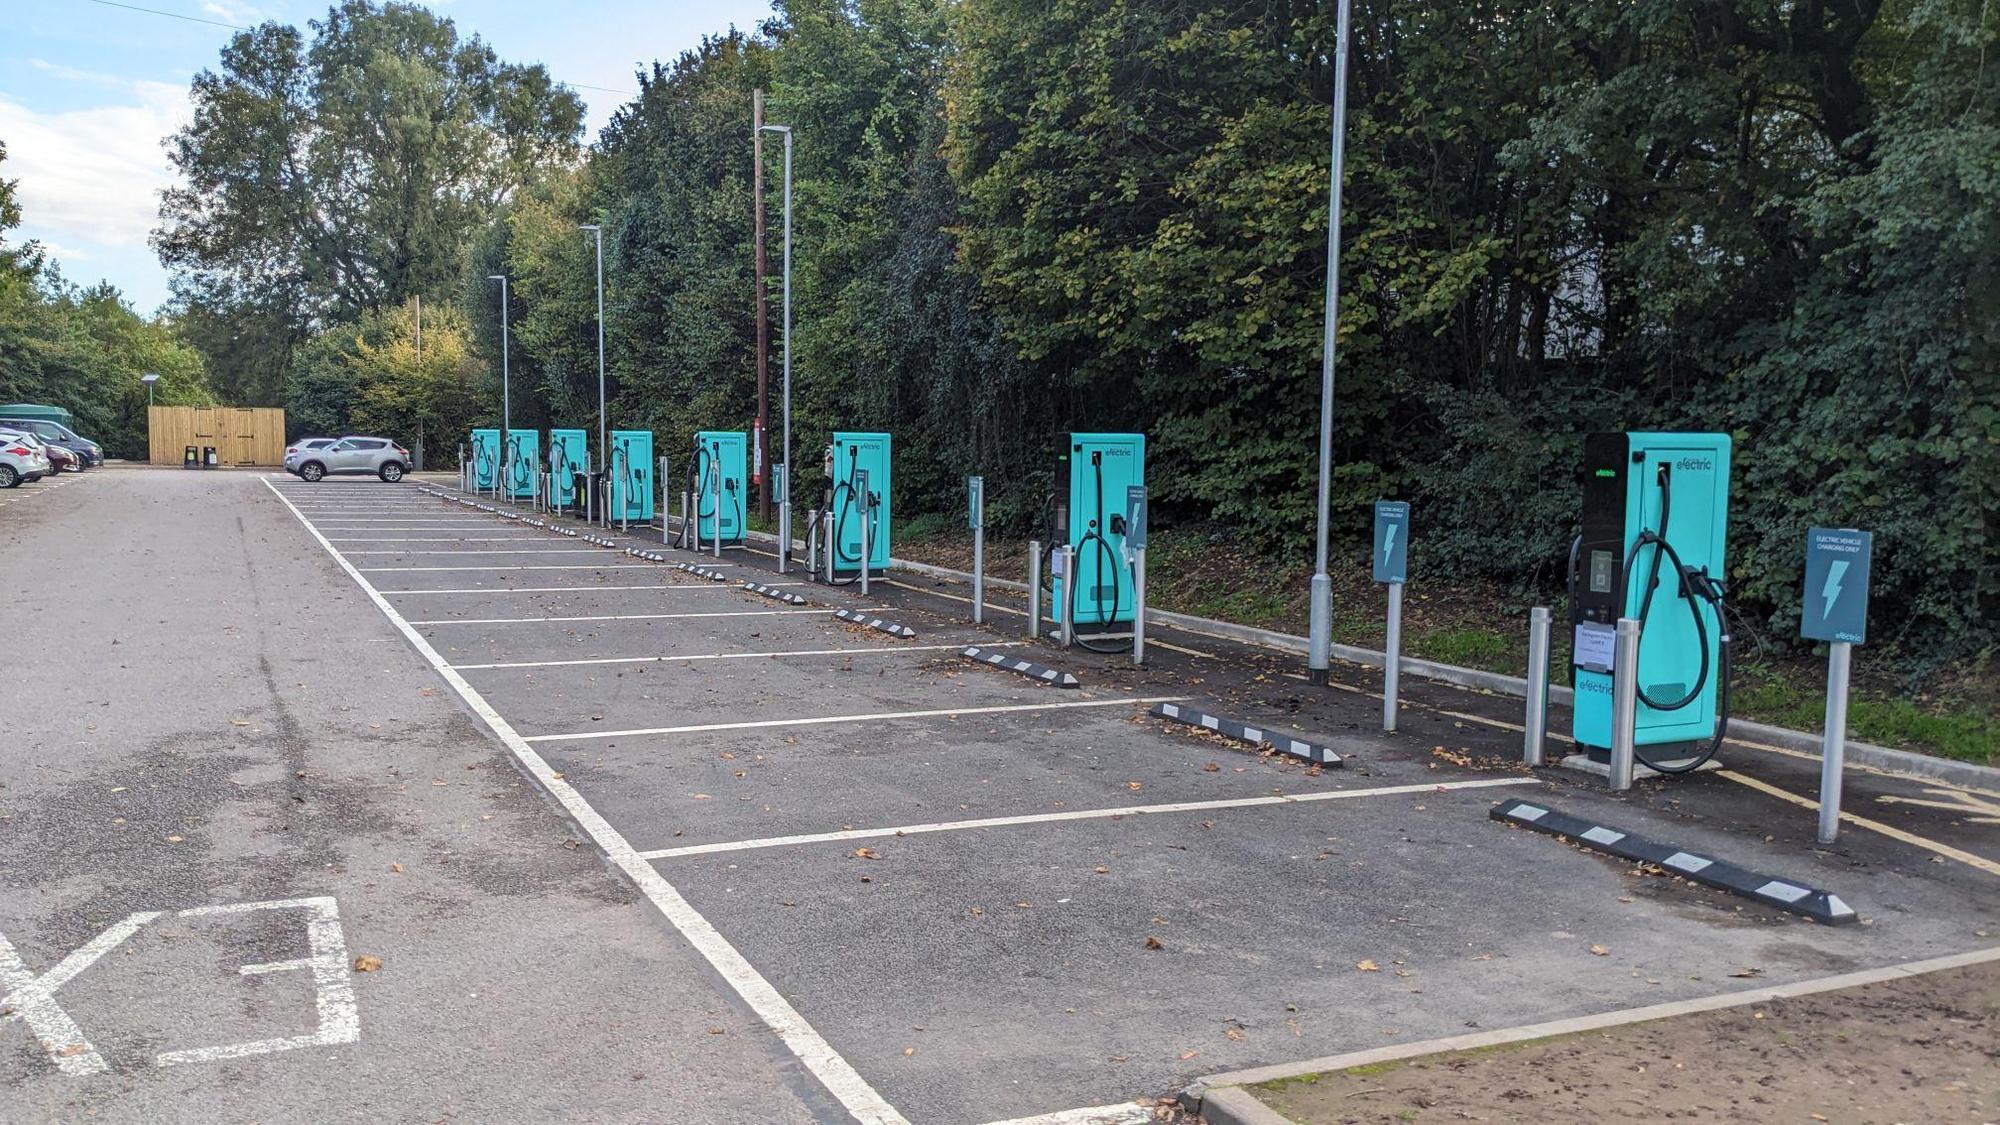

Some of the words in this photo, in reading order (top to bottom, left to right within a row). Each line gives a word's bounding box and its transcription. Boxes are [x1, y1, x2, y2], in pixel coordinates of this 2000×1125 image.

[1676, 457, 1712, 471] electric
[1816, 535, 1839, 543] ELECTRIC
[1817, 543, 1844, 552] CHARGING
[1579, 679, 1613, 696] electric
